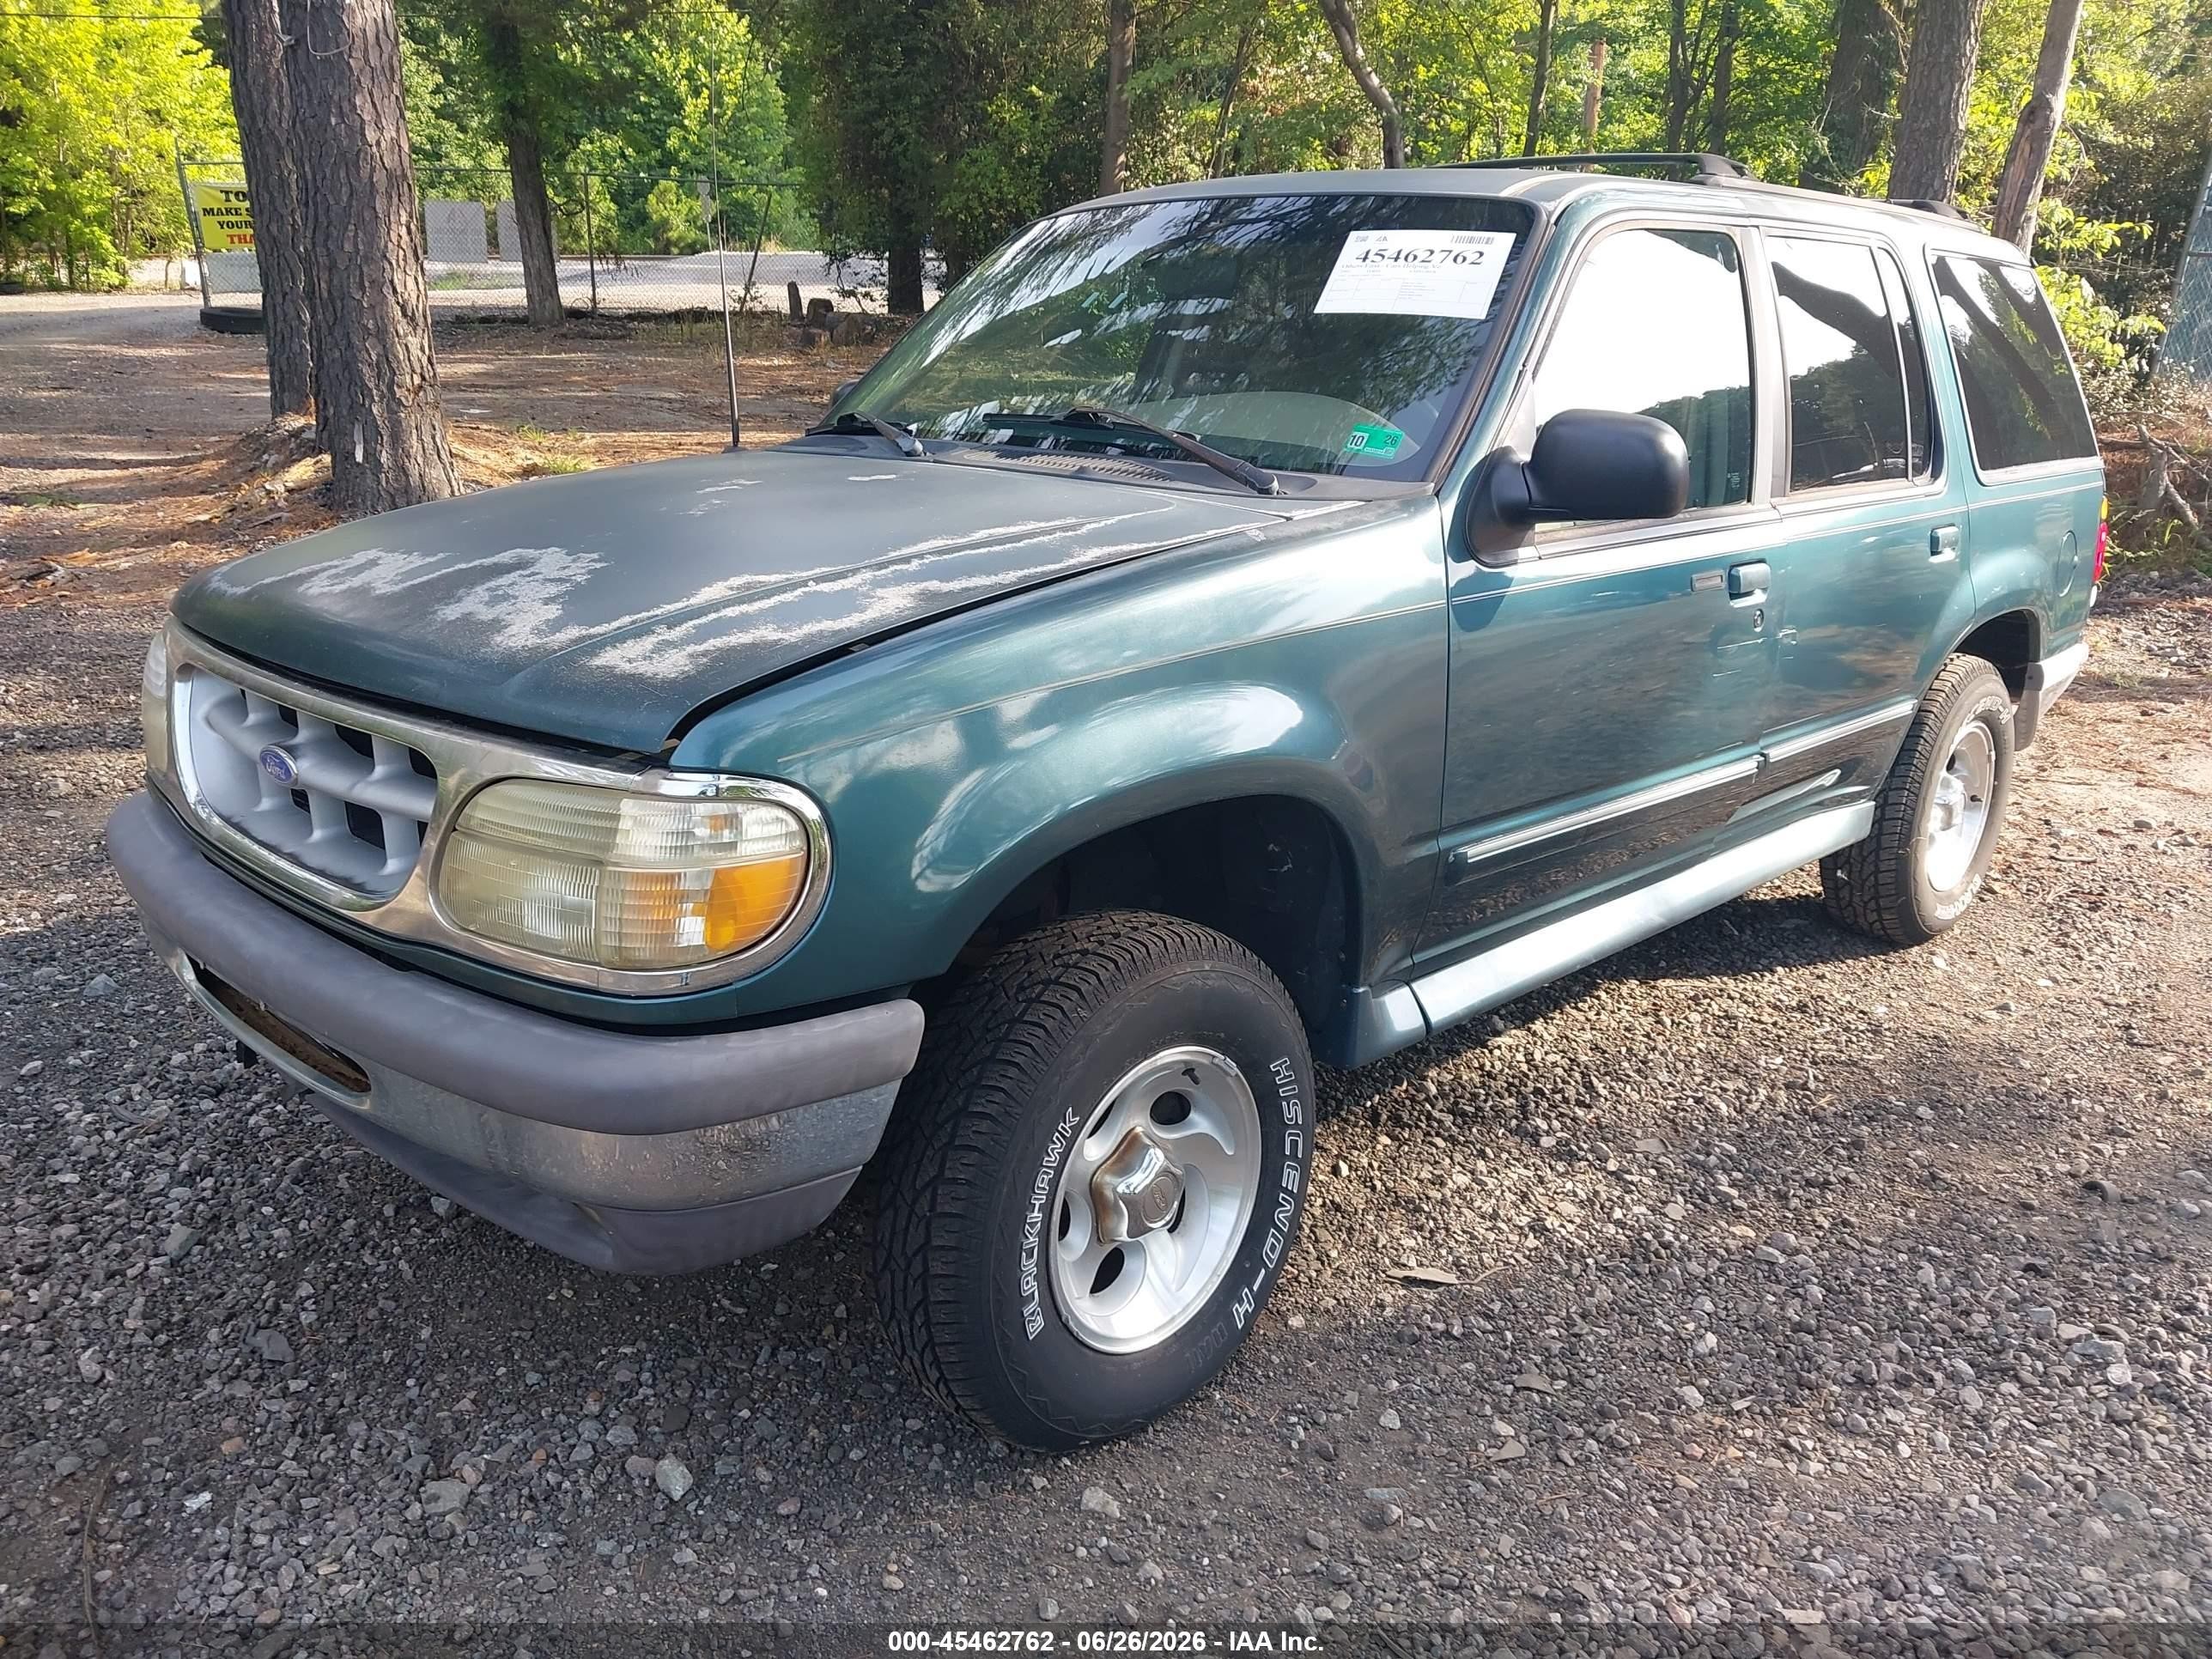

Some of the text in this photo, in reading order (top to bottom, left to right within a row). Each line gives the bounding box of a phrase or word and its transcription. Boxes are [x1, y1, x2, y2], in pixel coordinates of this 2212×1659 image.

[202, 207, 242, 216] MAKE
[1355, 248, 1485, 265] 45462762
[1350, 434, 1399, 447] 10 26
[266, 755, 287, 781] Ford
[1232, 1057, 1304, 1330] HISCEND-H
[1020, 1107, 1080, 1340] BLACKHAWK
